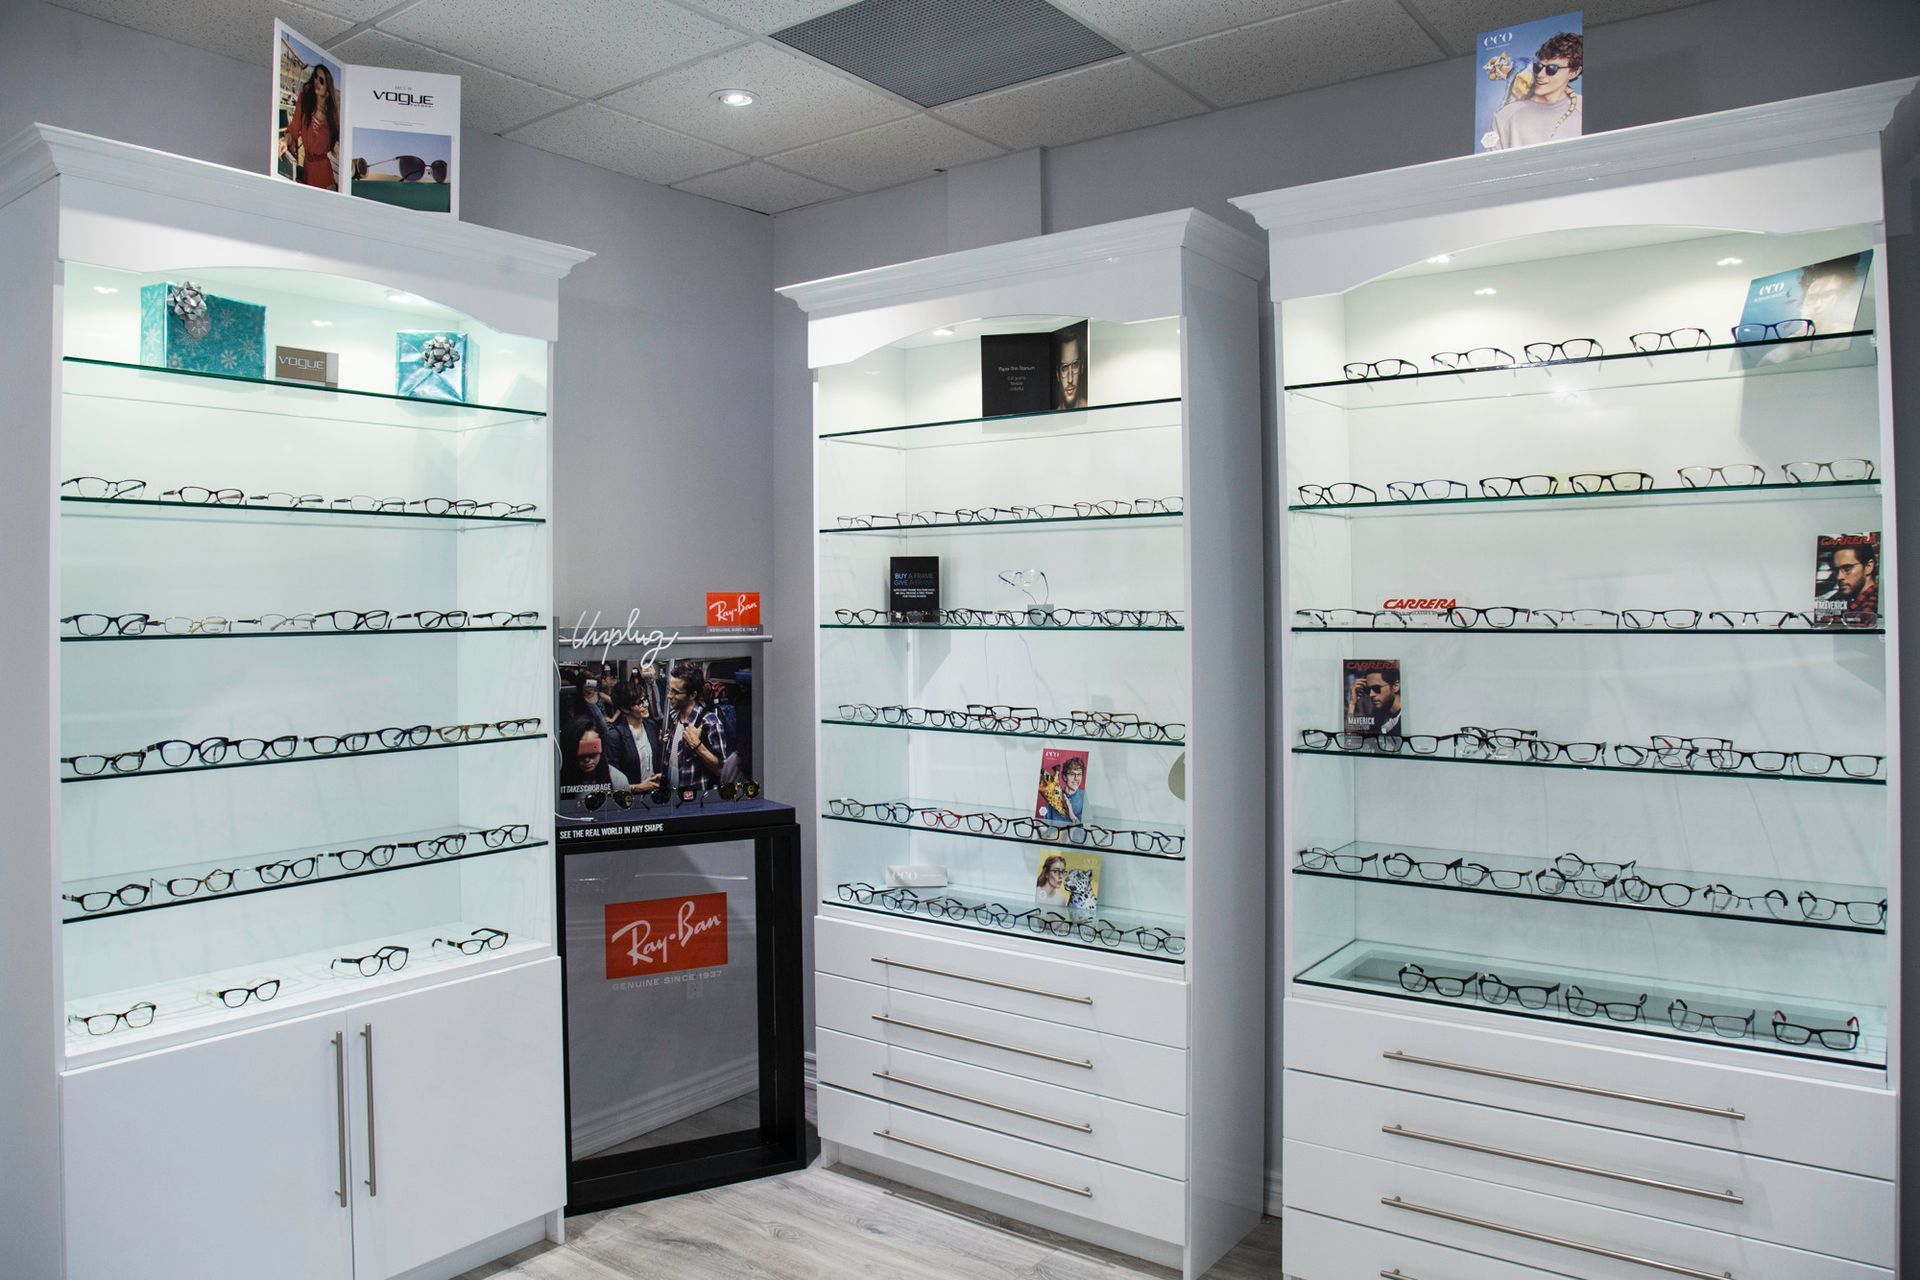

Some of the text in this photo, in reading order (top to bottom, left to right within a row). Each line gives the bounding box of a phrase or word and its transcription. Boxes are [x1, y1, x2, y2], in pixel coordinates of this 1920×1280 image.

[1383, 598, 1456, 609] CARRERA
[573, 608, 679, 669] Unplug
[1348, 717, 1375, 725] MAVERICK
[559, 823, 664, 839] SEE THE REAL WORLD IN ANY SHAPE
[611, 970, 722, 991] GENUINE SINCE 1937
